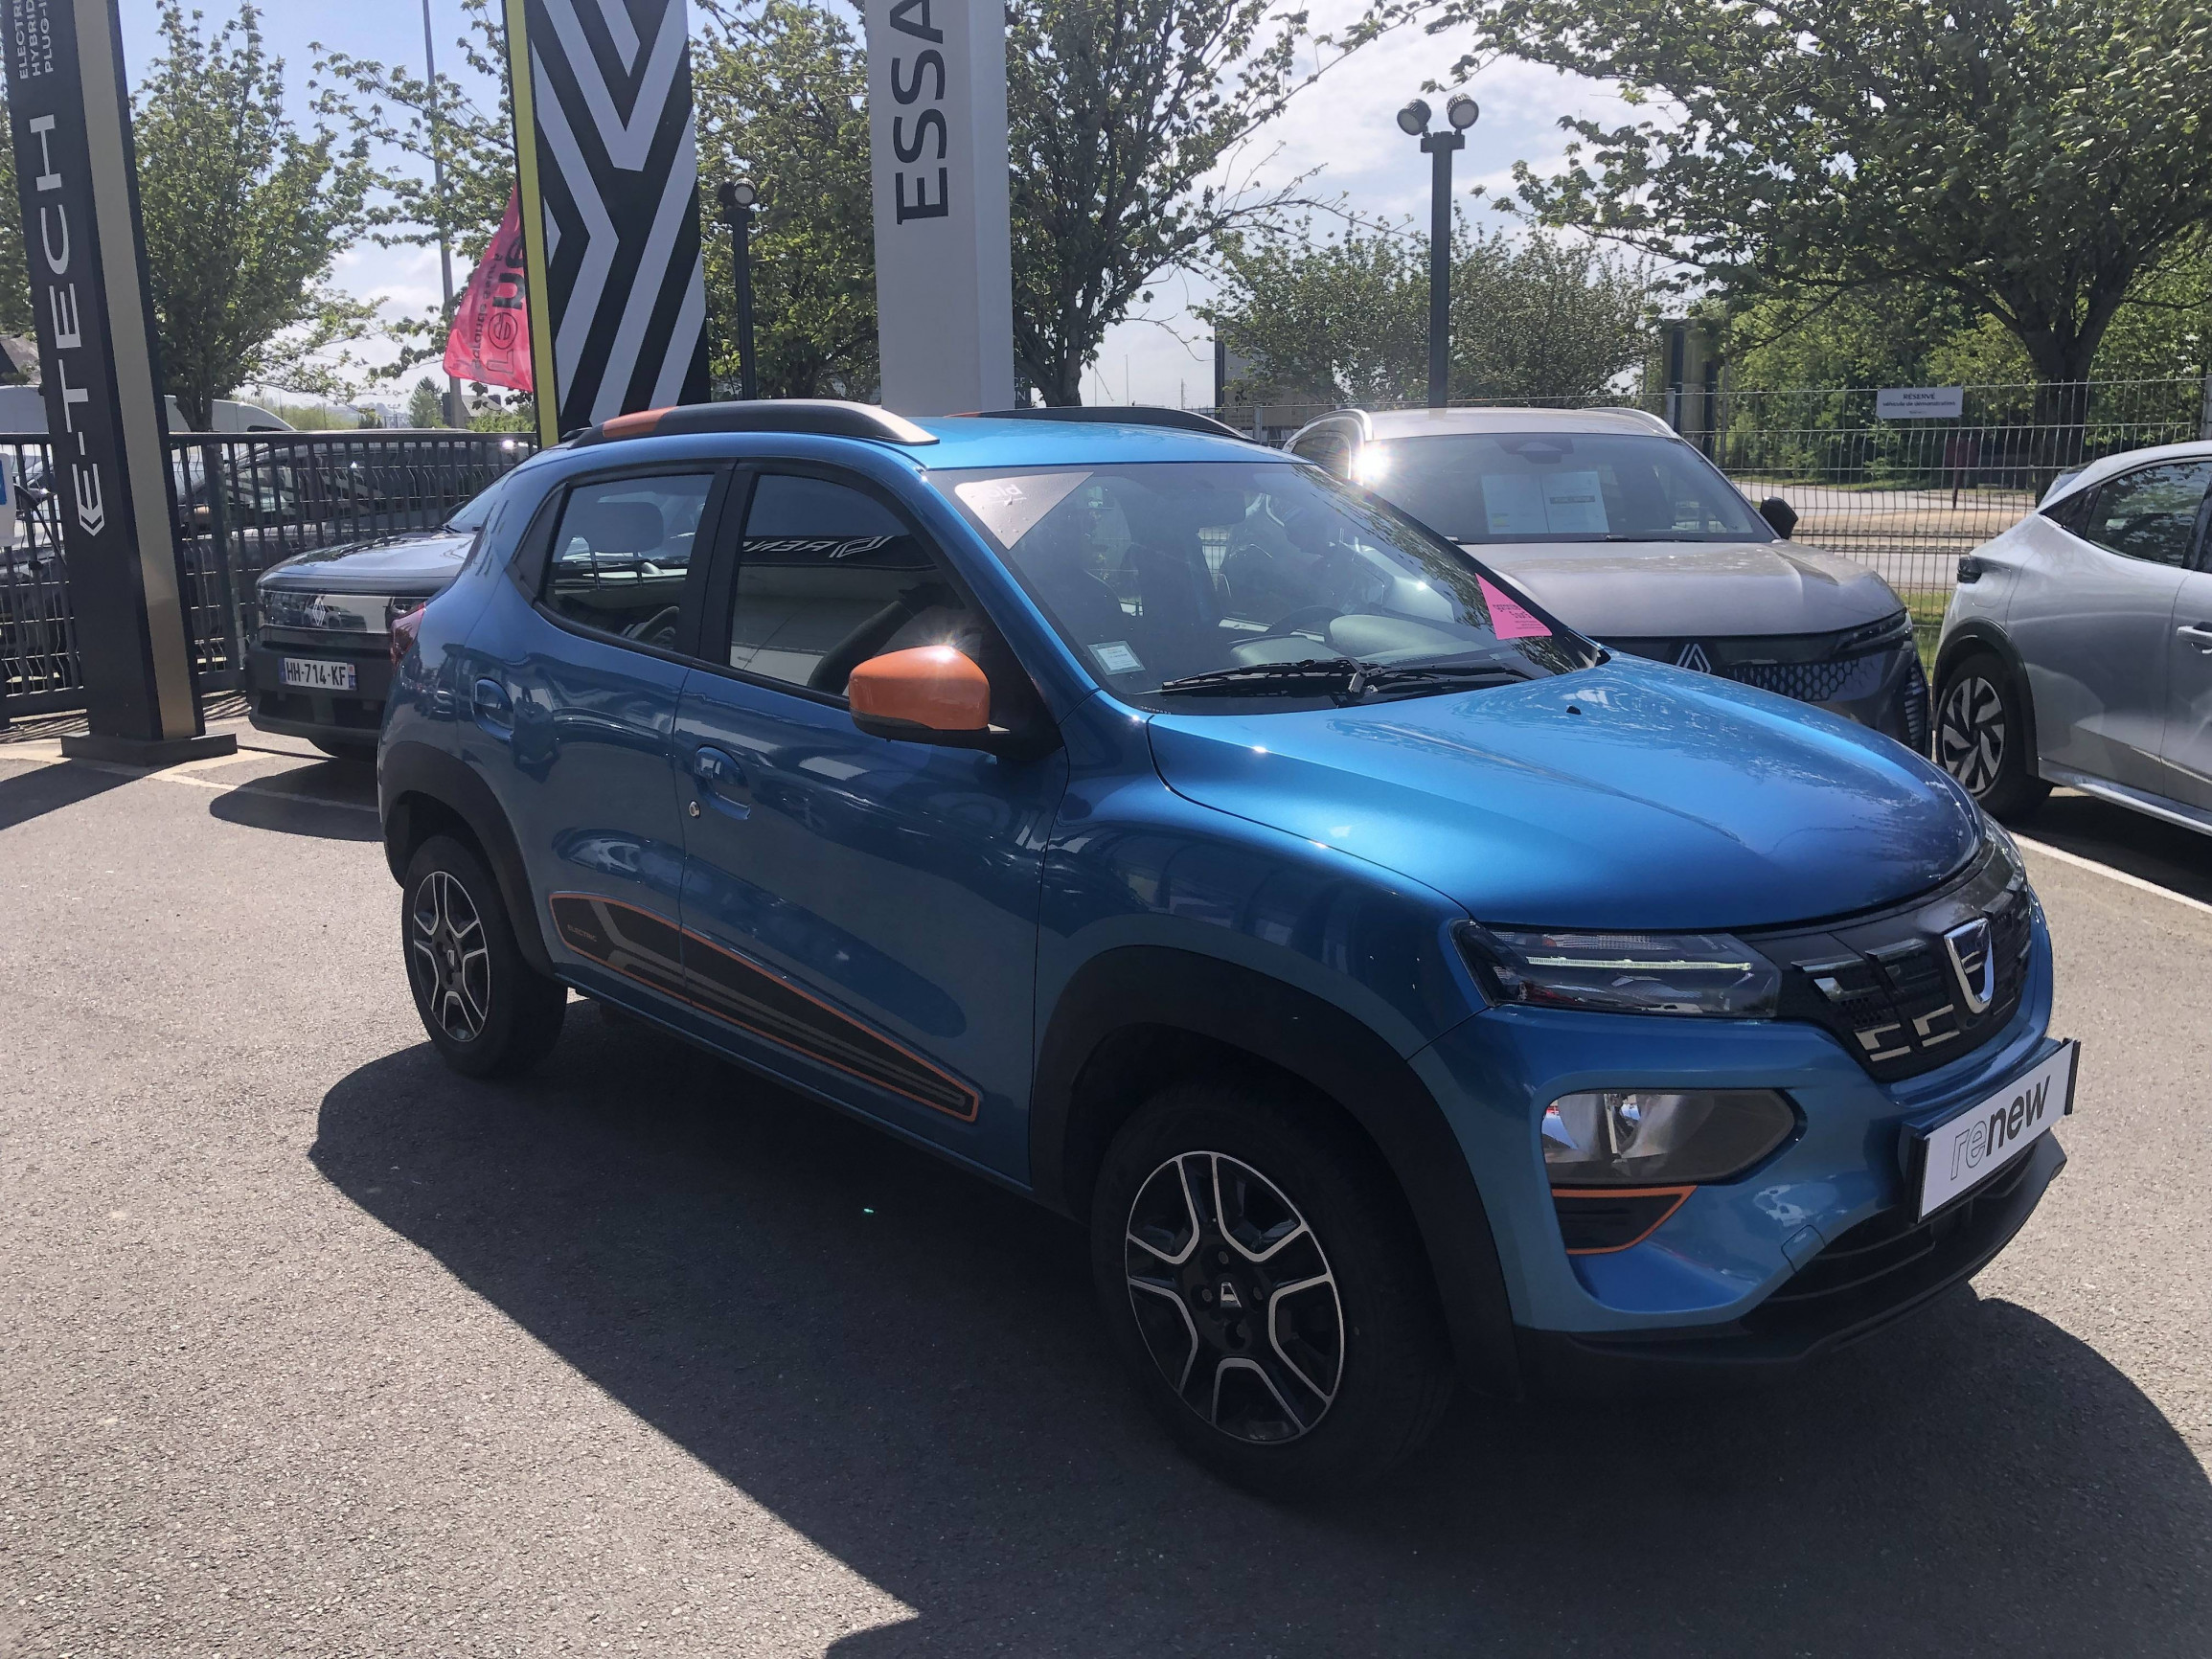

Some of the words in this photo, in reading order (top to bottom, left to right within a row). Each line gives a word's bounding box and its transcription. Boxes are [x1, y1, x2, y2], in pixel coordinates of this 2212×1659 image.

[26, 0, 41, 77] HYBRID
[30, 114, 105, 536] E-TECH
[285, 661, 347, 686] HH-714-KF
[1950, 1075, 2051, 1181] renew
